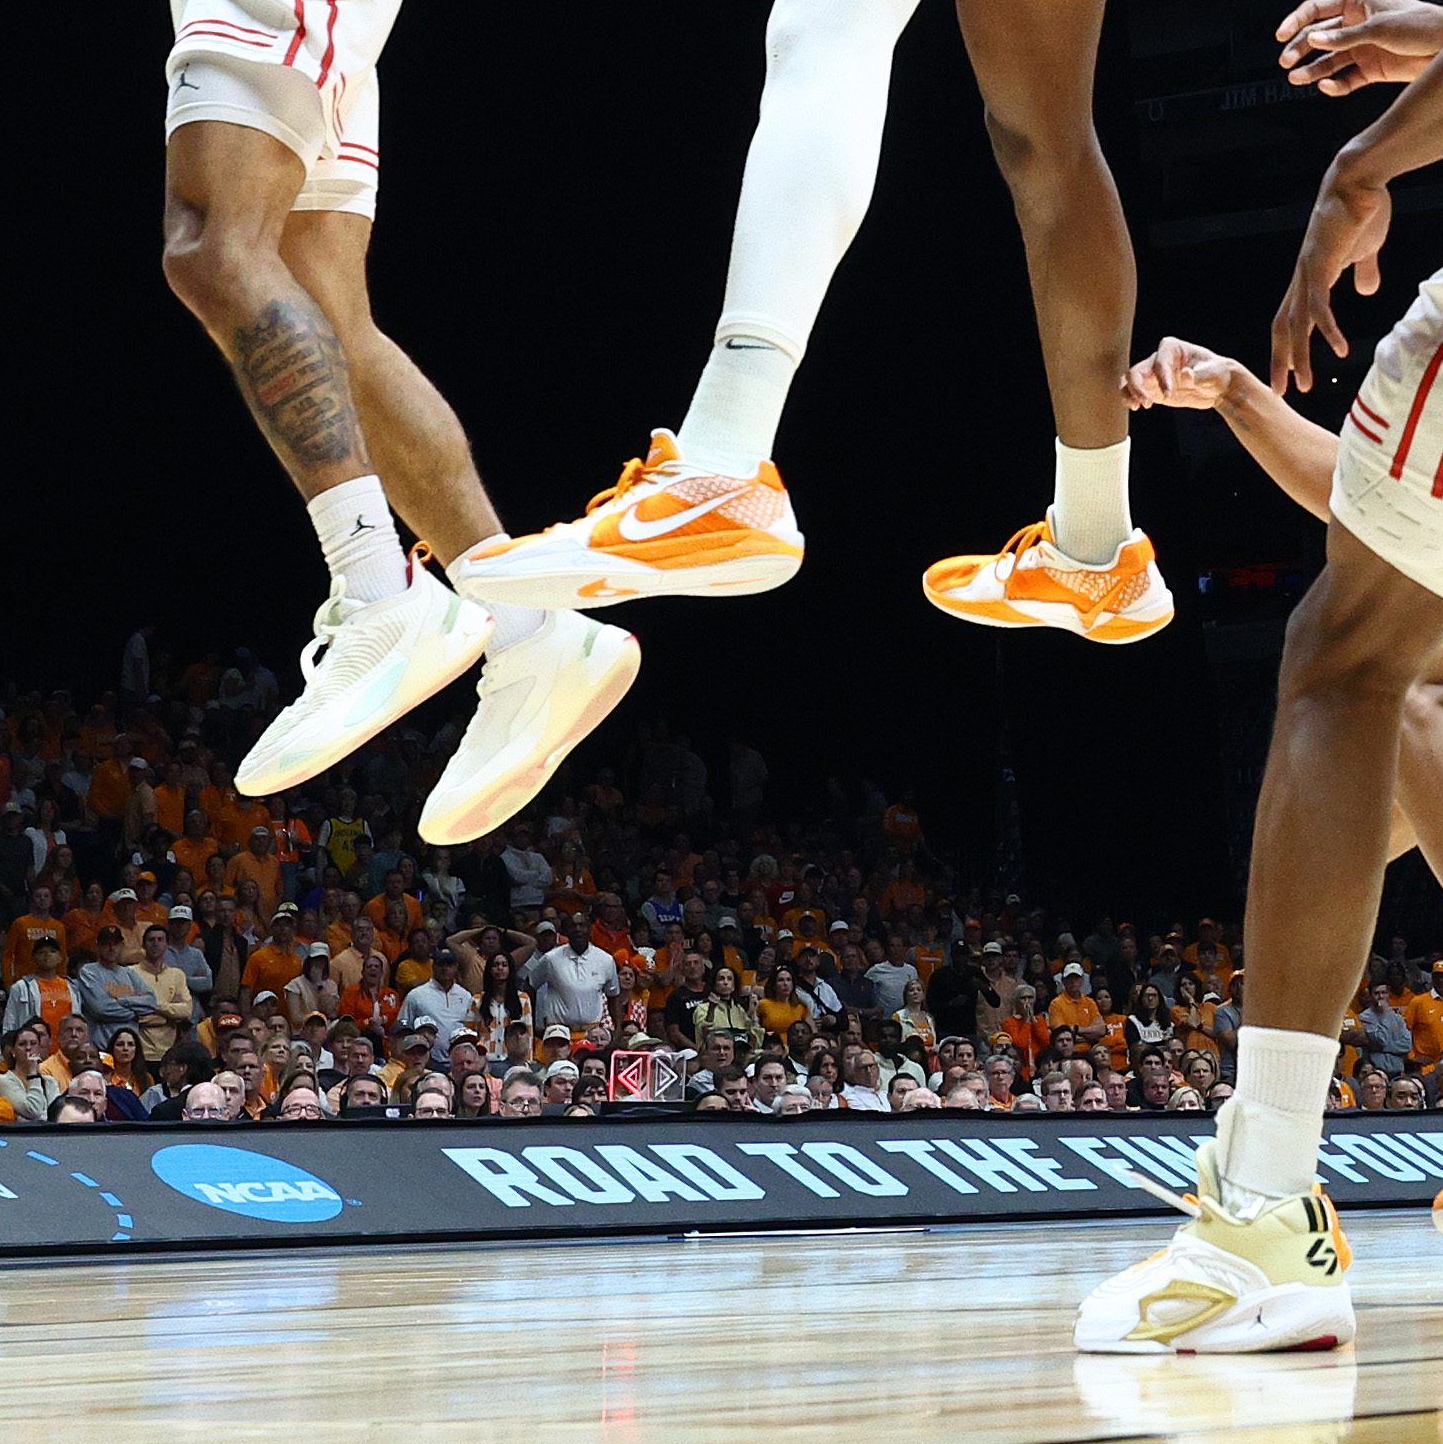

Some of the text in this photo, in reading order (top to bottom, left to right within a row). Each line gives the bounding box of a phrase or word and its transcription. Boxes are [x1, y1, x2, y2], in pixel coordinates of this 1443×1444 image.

[193, 1180, 342, 1205] NCAA
[440, 1144, 767, 1211] ROAD
[734, 1143, 911, 1202] TO
[875, 1139, 1098, 1198] THE
